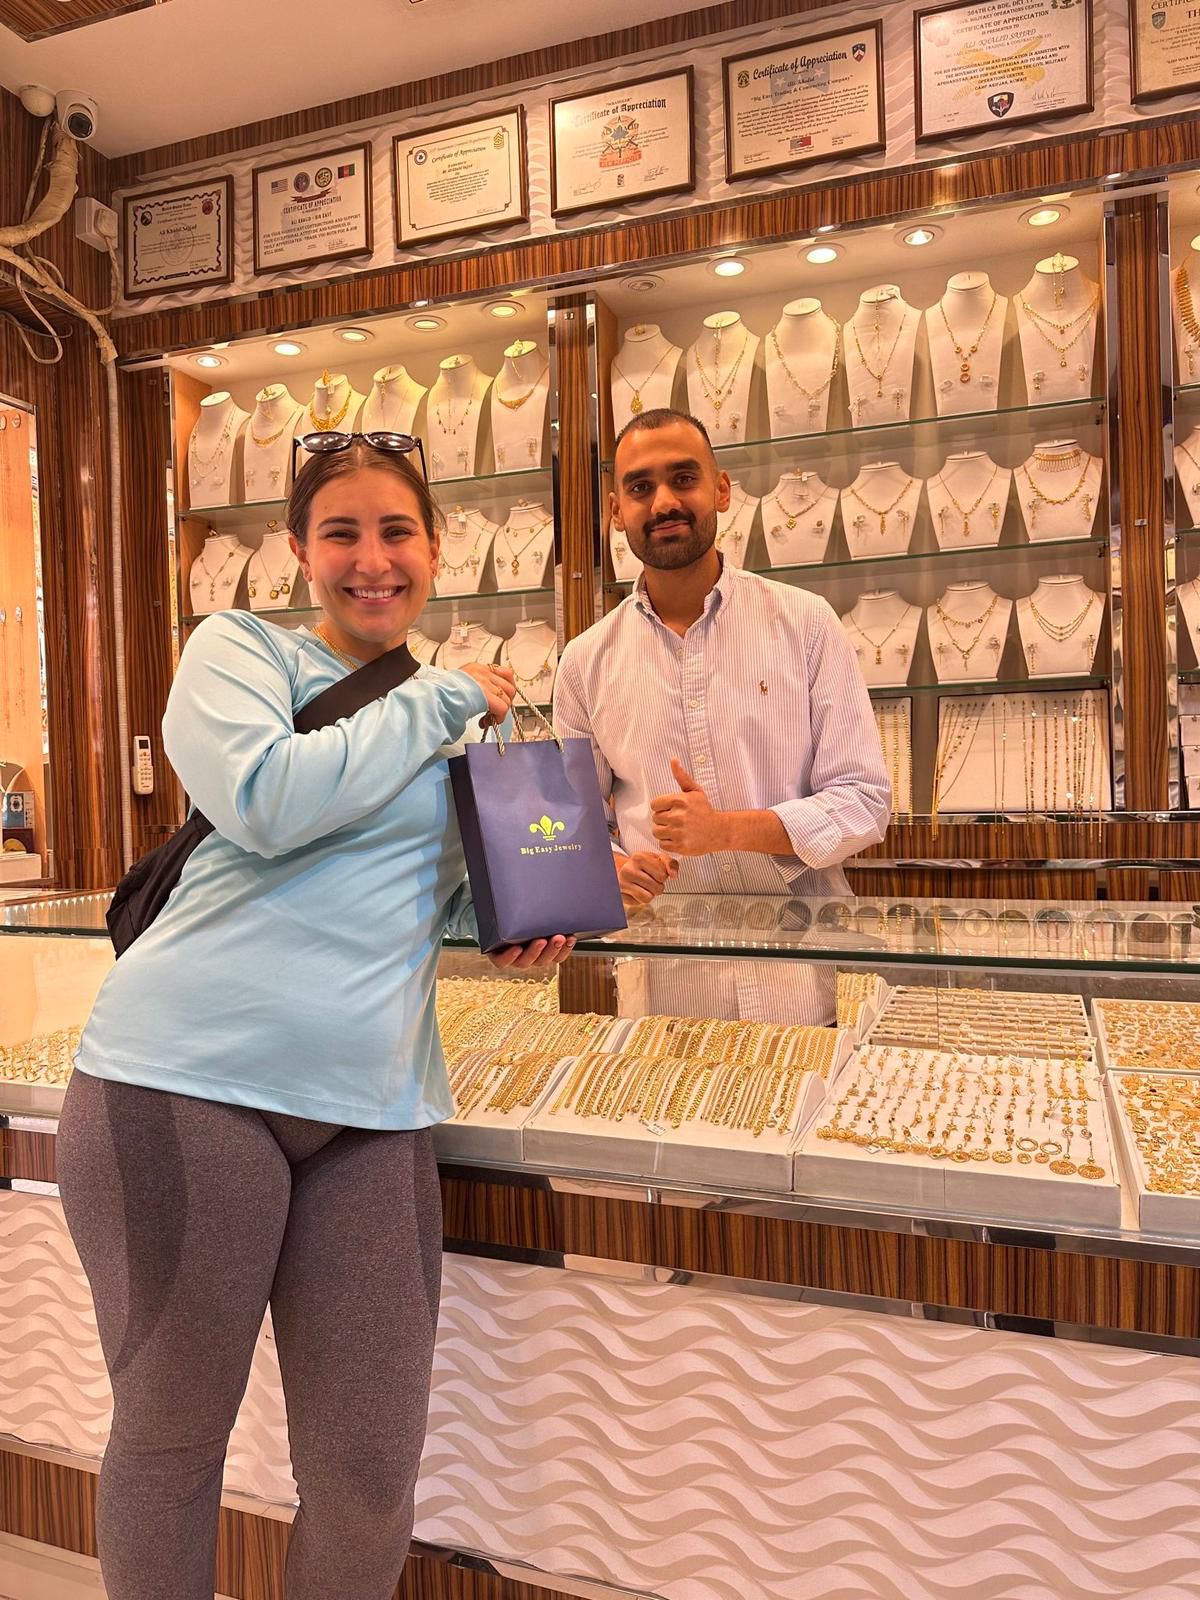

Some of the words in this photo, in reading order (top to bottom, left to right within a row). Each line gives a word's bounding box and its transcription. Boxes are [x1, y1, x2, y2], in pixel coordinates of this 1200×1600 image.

[952, 21, 992, 35] CERTIFICATE
[1002, 9, 1048, 24] APPRECIATION
[970, 13, 993, 22] MILITARY
[993, 6, 1023, 17] OPERATIONS
[1024, 2, 1043, 10] CENTER
[753, 61, 789, 80] Certificate
[790, 57, 799, 72] of
[800, 51, 848, 70] Appreciation
[612, 107, 619, 115] of
[621, 97, 667, 112] Appreciation
[520, 847, 534, 855] Big
[554, 843, 582, 852] Jewelry
